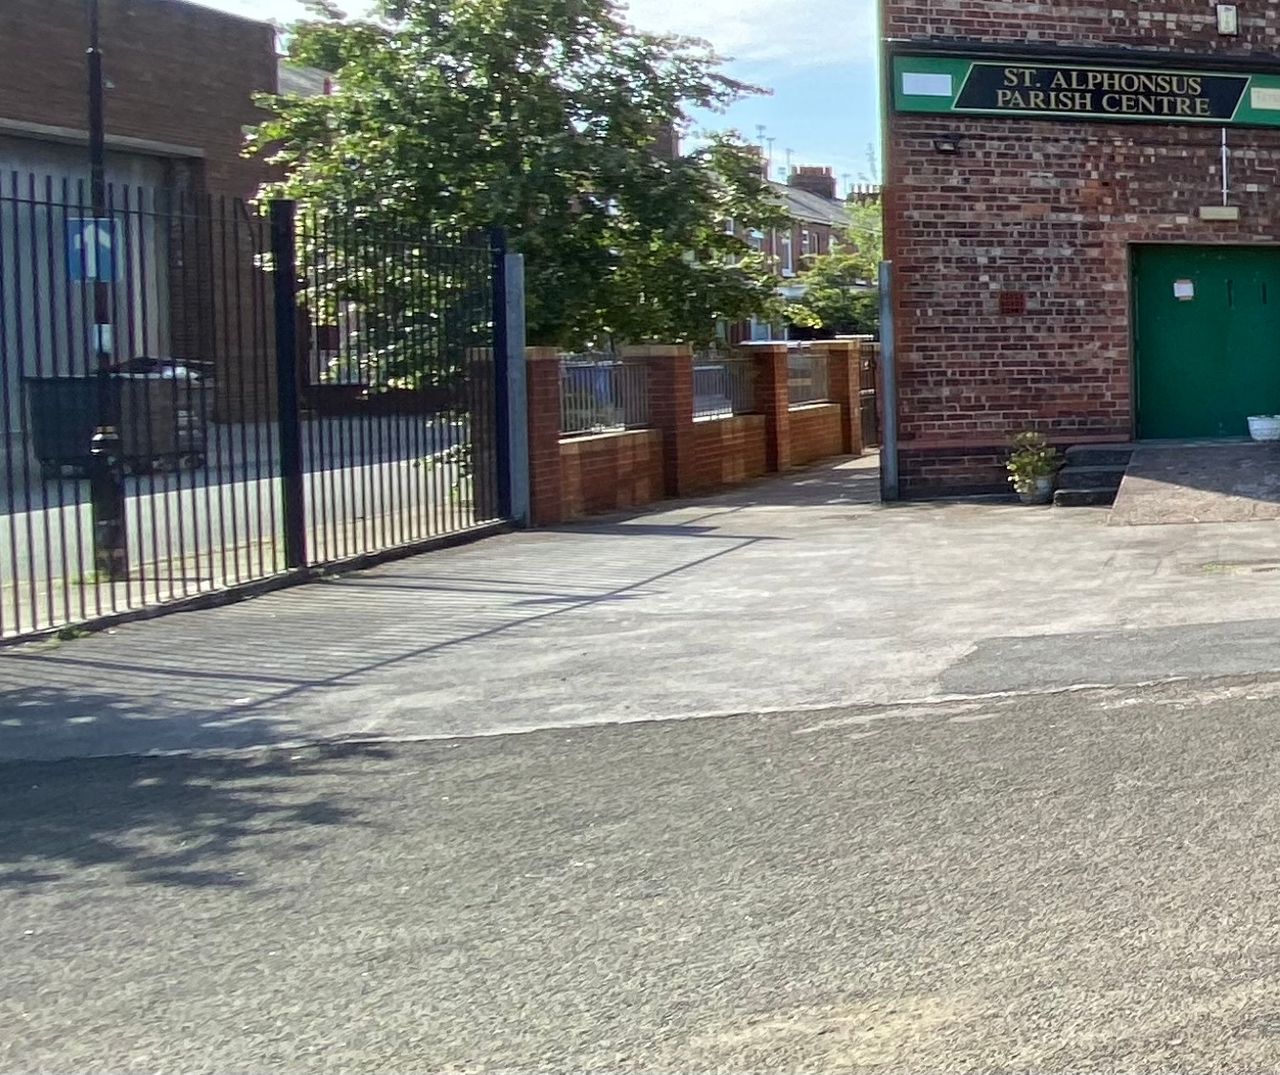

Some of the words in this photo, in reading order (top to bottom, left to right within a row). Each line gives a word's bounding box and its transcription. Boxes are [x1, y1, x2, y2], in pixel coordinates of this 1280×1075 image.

[1004, 68, 1041, 88] ST.
[1050, 71, 1202, 95] ALPHONSUS
[996, 89, 1092, 111] PARISH
[1102, 93, 1211, 116] CENTRE
